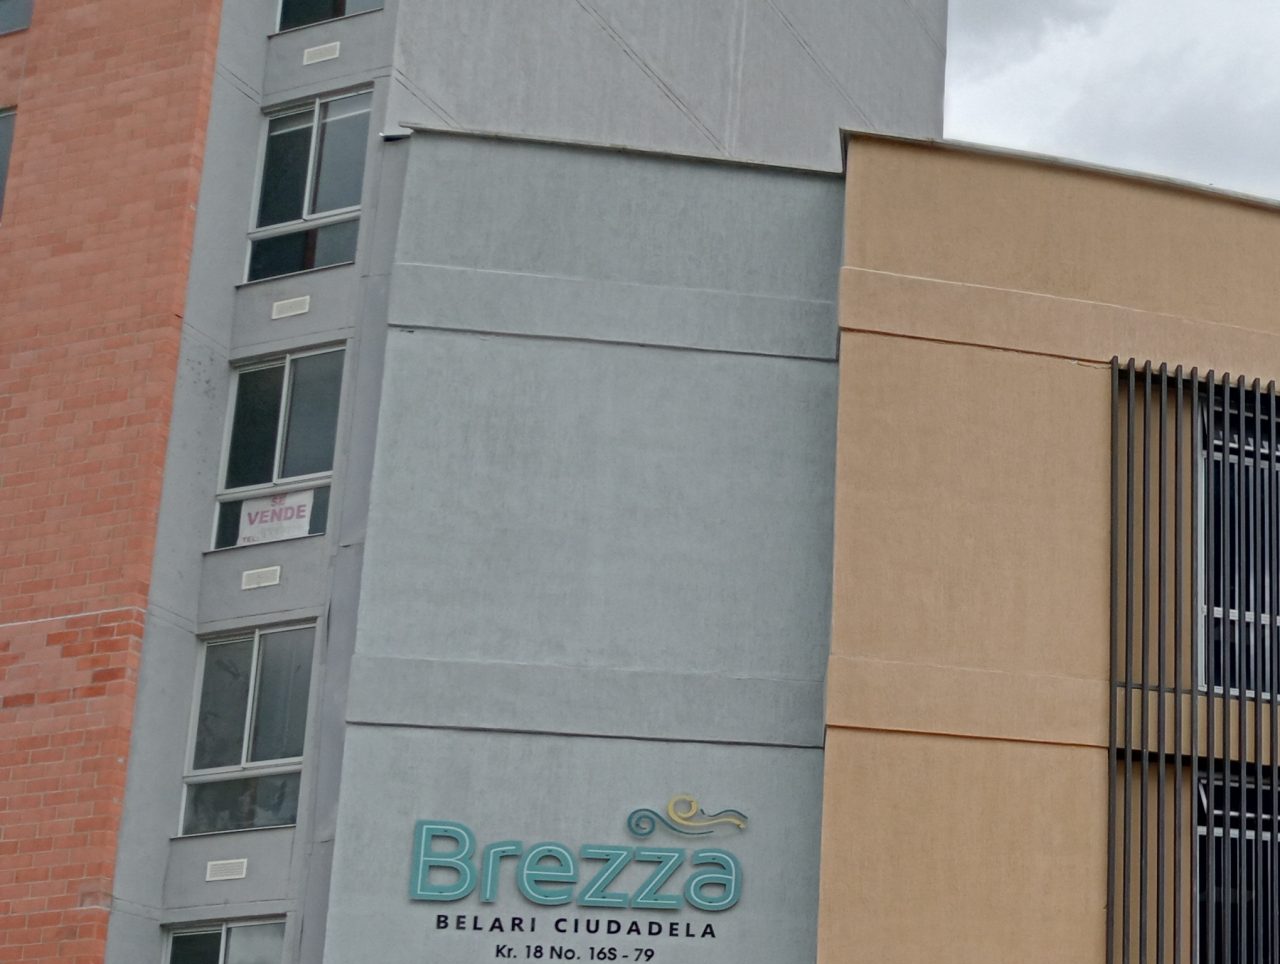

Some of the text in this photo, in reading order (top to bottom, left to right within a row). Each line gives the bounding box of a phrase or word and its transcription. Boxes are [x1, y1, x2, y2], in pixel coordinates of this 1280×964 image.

[247, 504, 307, 526] VENDE
[409, 819, 743, 911] Brezza
[436, 914, 717, 938] BELARI CIUDADELA
[495, 944, 517, 959] Kr.
[525, 944, 544, 959] 18
[549, 945, 581, 961] No.
[633, 948, 655, 962] 79
